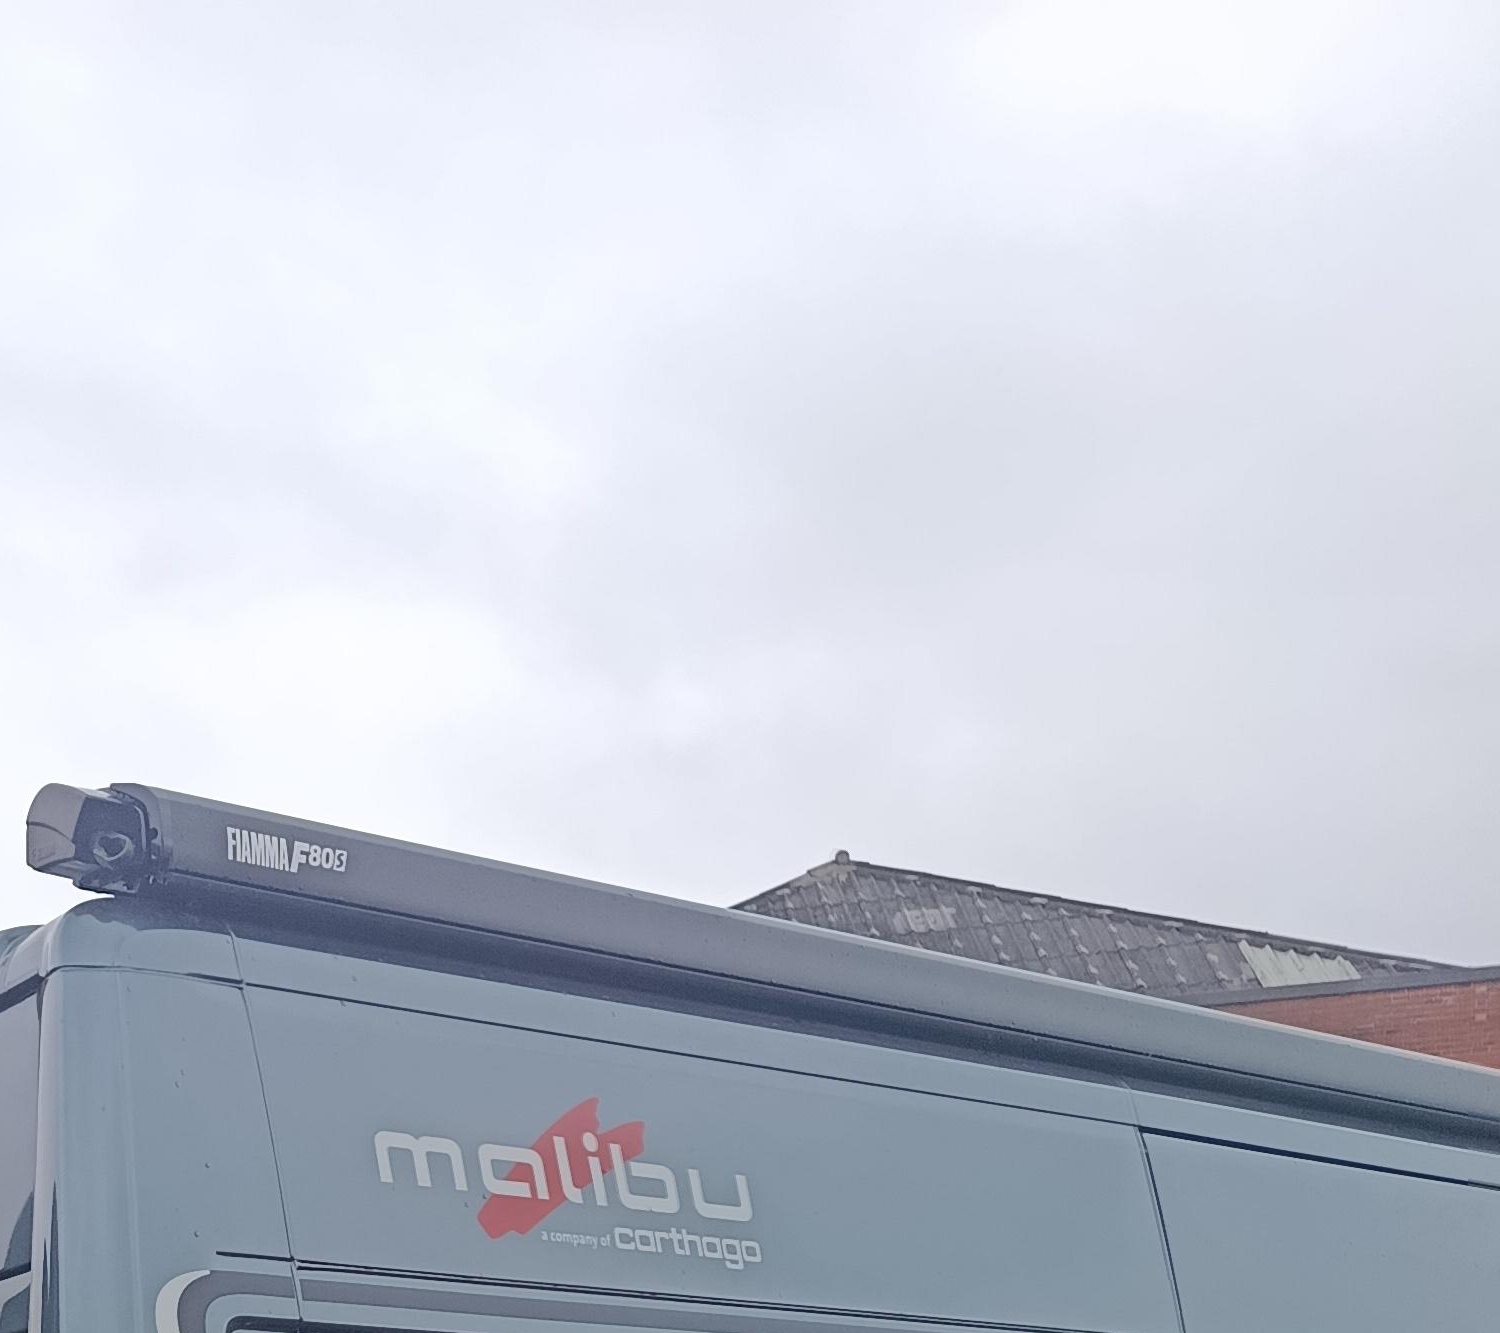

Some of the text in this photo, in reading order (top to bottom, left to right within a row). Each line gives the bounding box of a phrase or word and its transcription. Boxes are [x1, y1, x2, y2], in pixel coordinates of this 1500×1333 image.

[227, 826, 289, 872] FIAMMA
[374, 1130, 753, 1222] malibu
[550, 1231, 598, 1249] company
[600, 1234, 612, 1247] of
[614, 1226, 762, 1270] carthago
